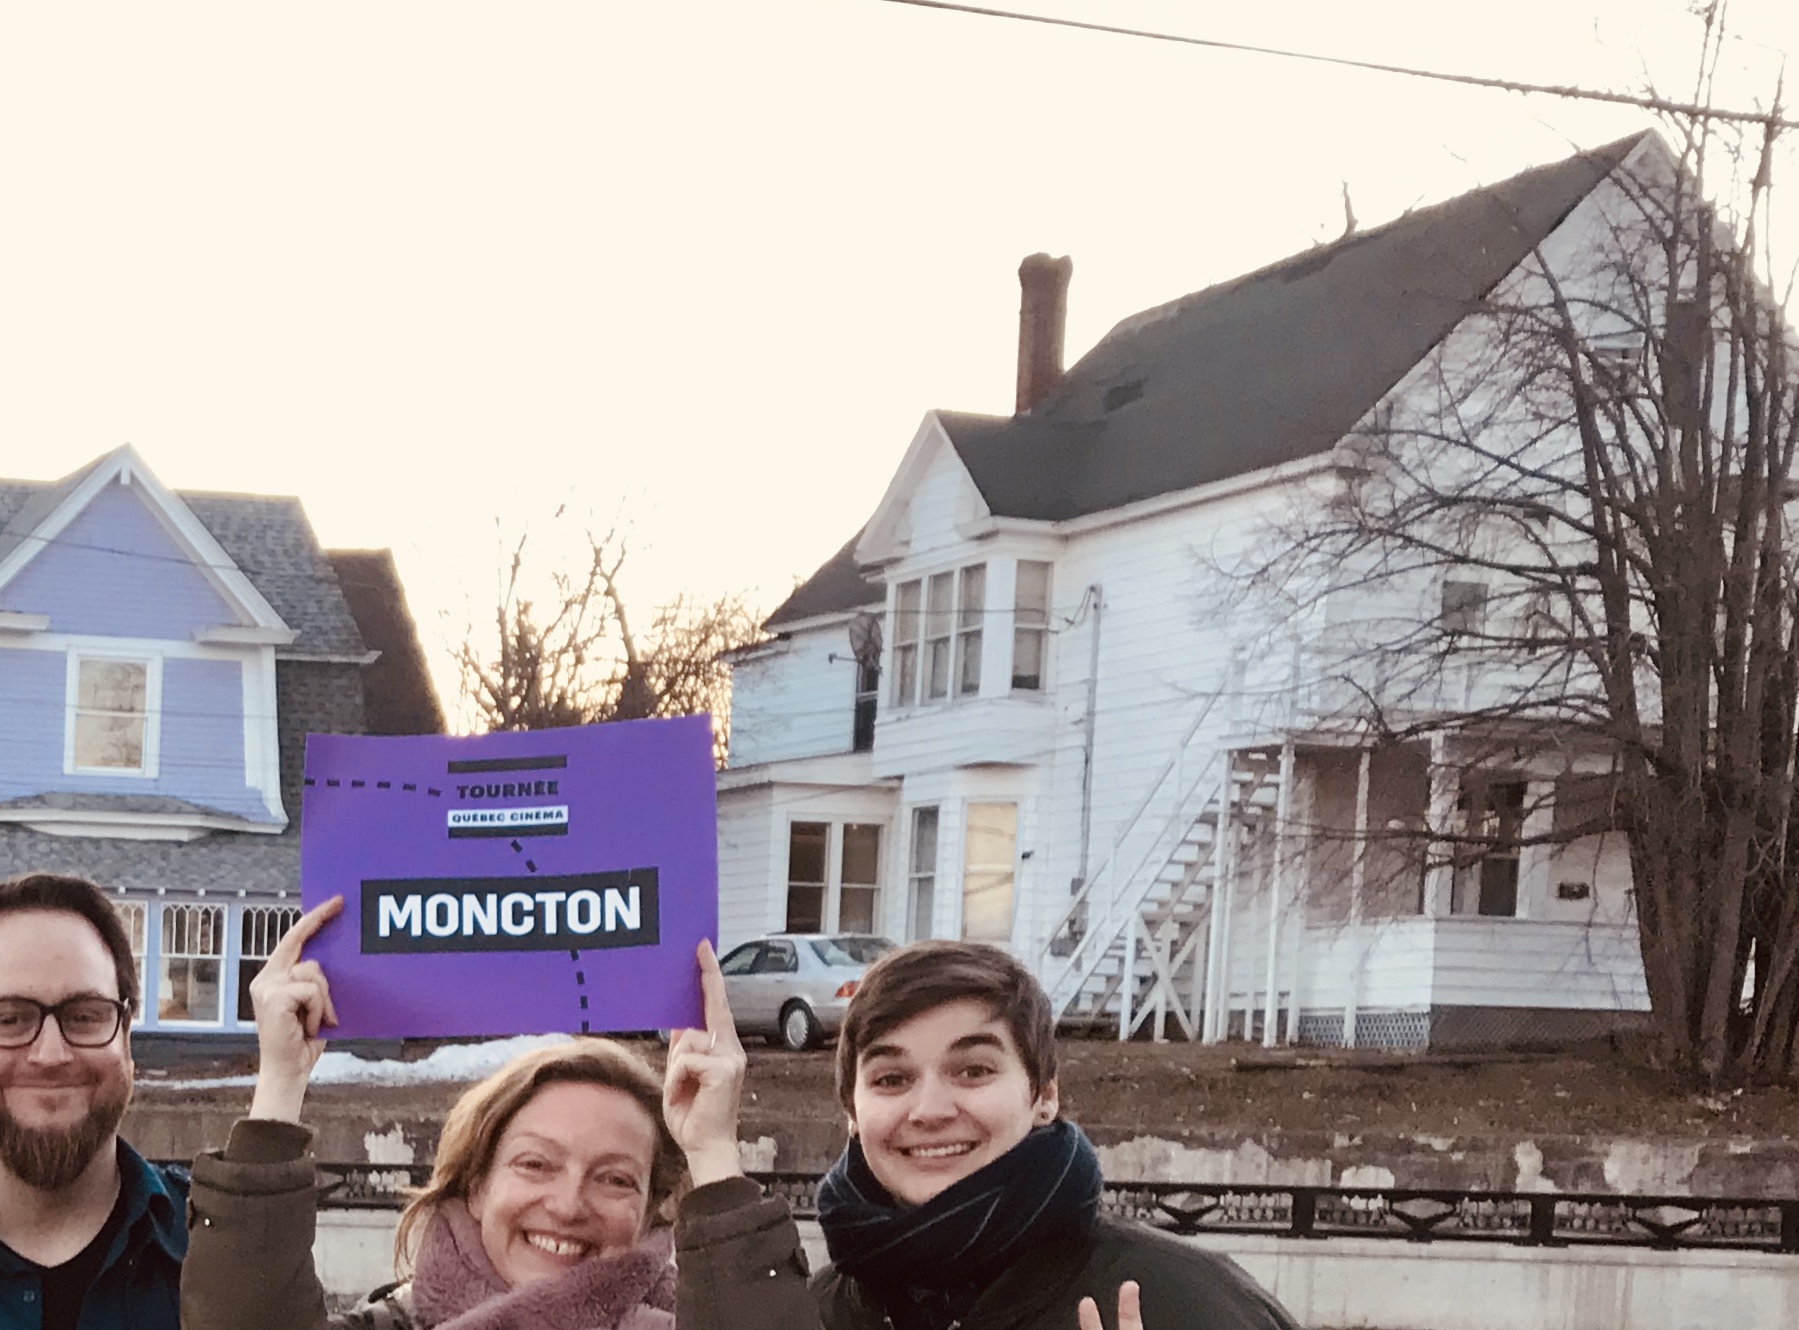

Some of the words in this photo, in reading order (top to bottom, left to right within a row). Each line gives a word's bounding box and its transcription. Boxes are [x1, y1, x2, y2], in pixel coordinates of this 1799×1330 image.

[456, 779, 559, 799] TOURNÉE
[452, 812, 506, 823] QUÉBEC
[378, 885, 642, 938] MONCTON
